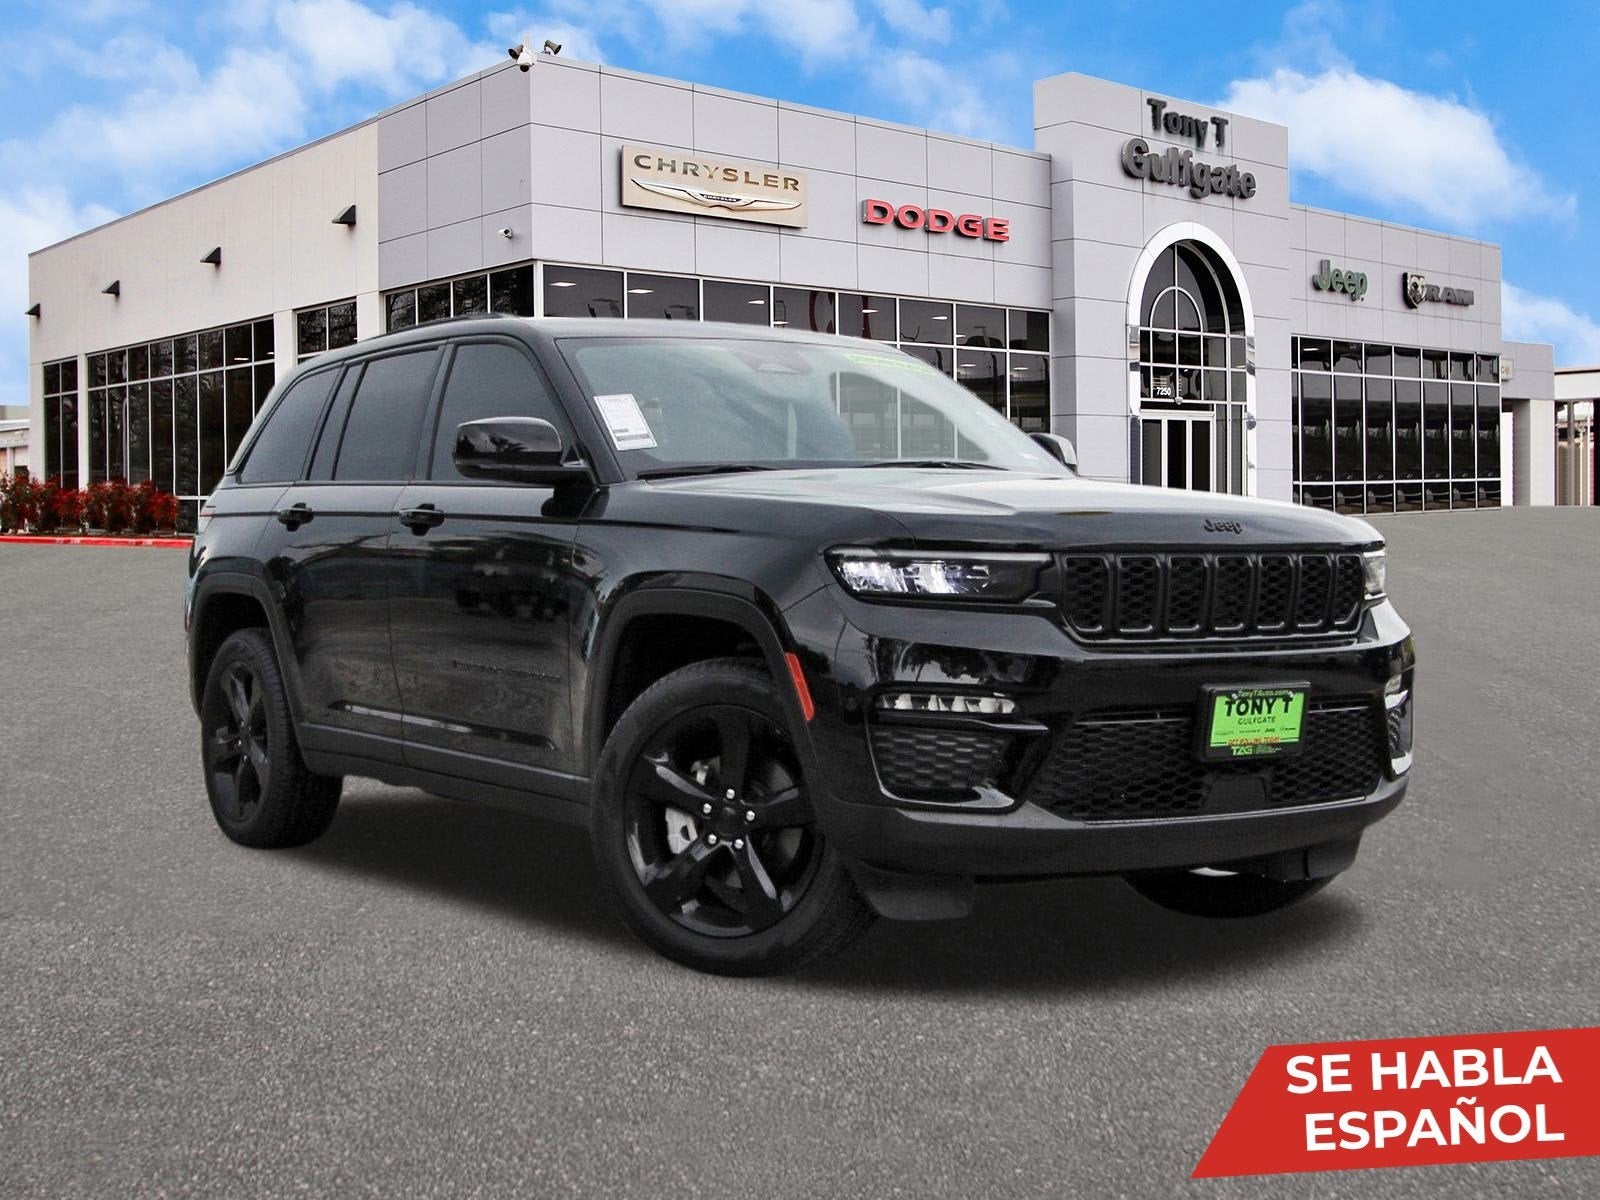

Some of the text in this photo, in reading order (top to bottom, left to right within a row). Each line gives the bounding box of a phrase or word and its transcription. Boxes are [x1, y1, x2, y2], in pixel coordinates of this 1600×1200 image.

[1146, 97, 1229, 148] Tony T
[633, 154, 801, 192] CHRYSLER
[1121, 137, 1256, 199] Gulfgate
[862, 198, 1011, 243] DODGE
[1312, 259, 1368, 302] Jeep
[1424, 283, 1475, 307] RAM
[1156, 386, 1172, 396] 7250
[1203, 519, 1243, 535] Jeep
[1225, 695, 1293, 717] TONY T
